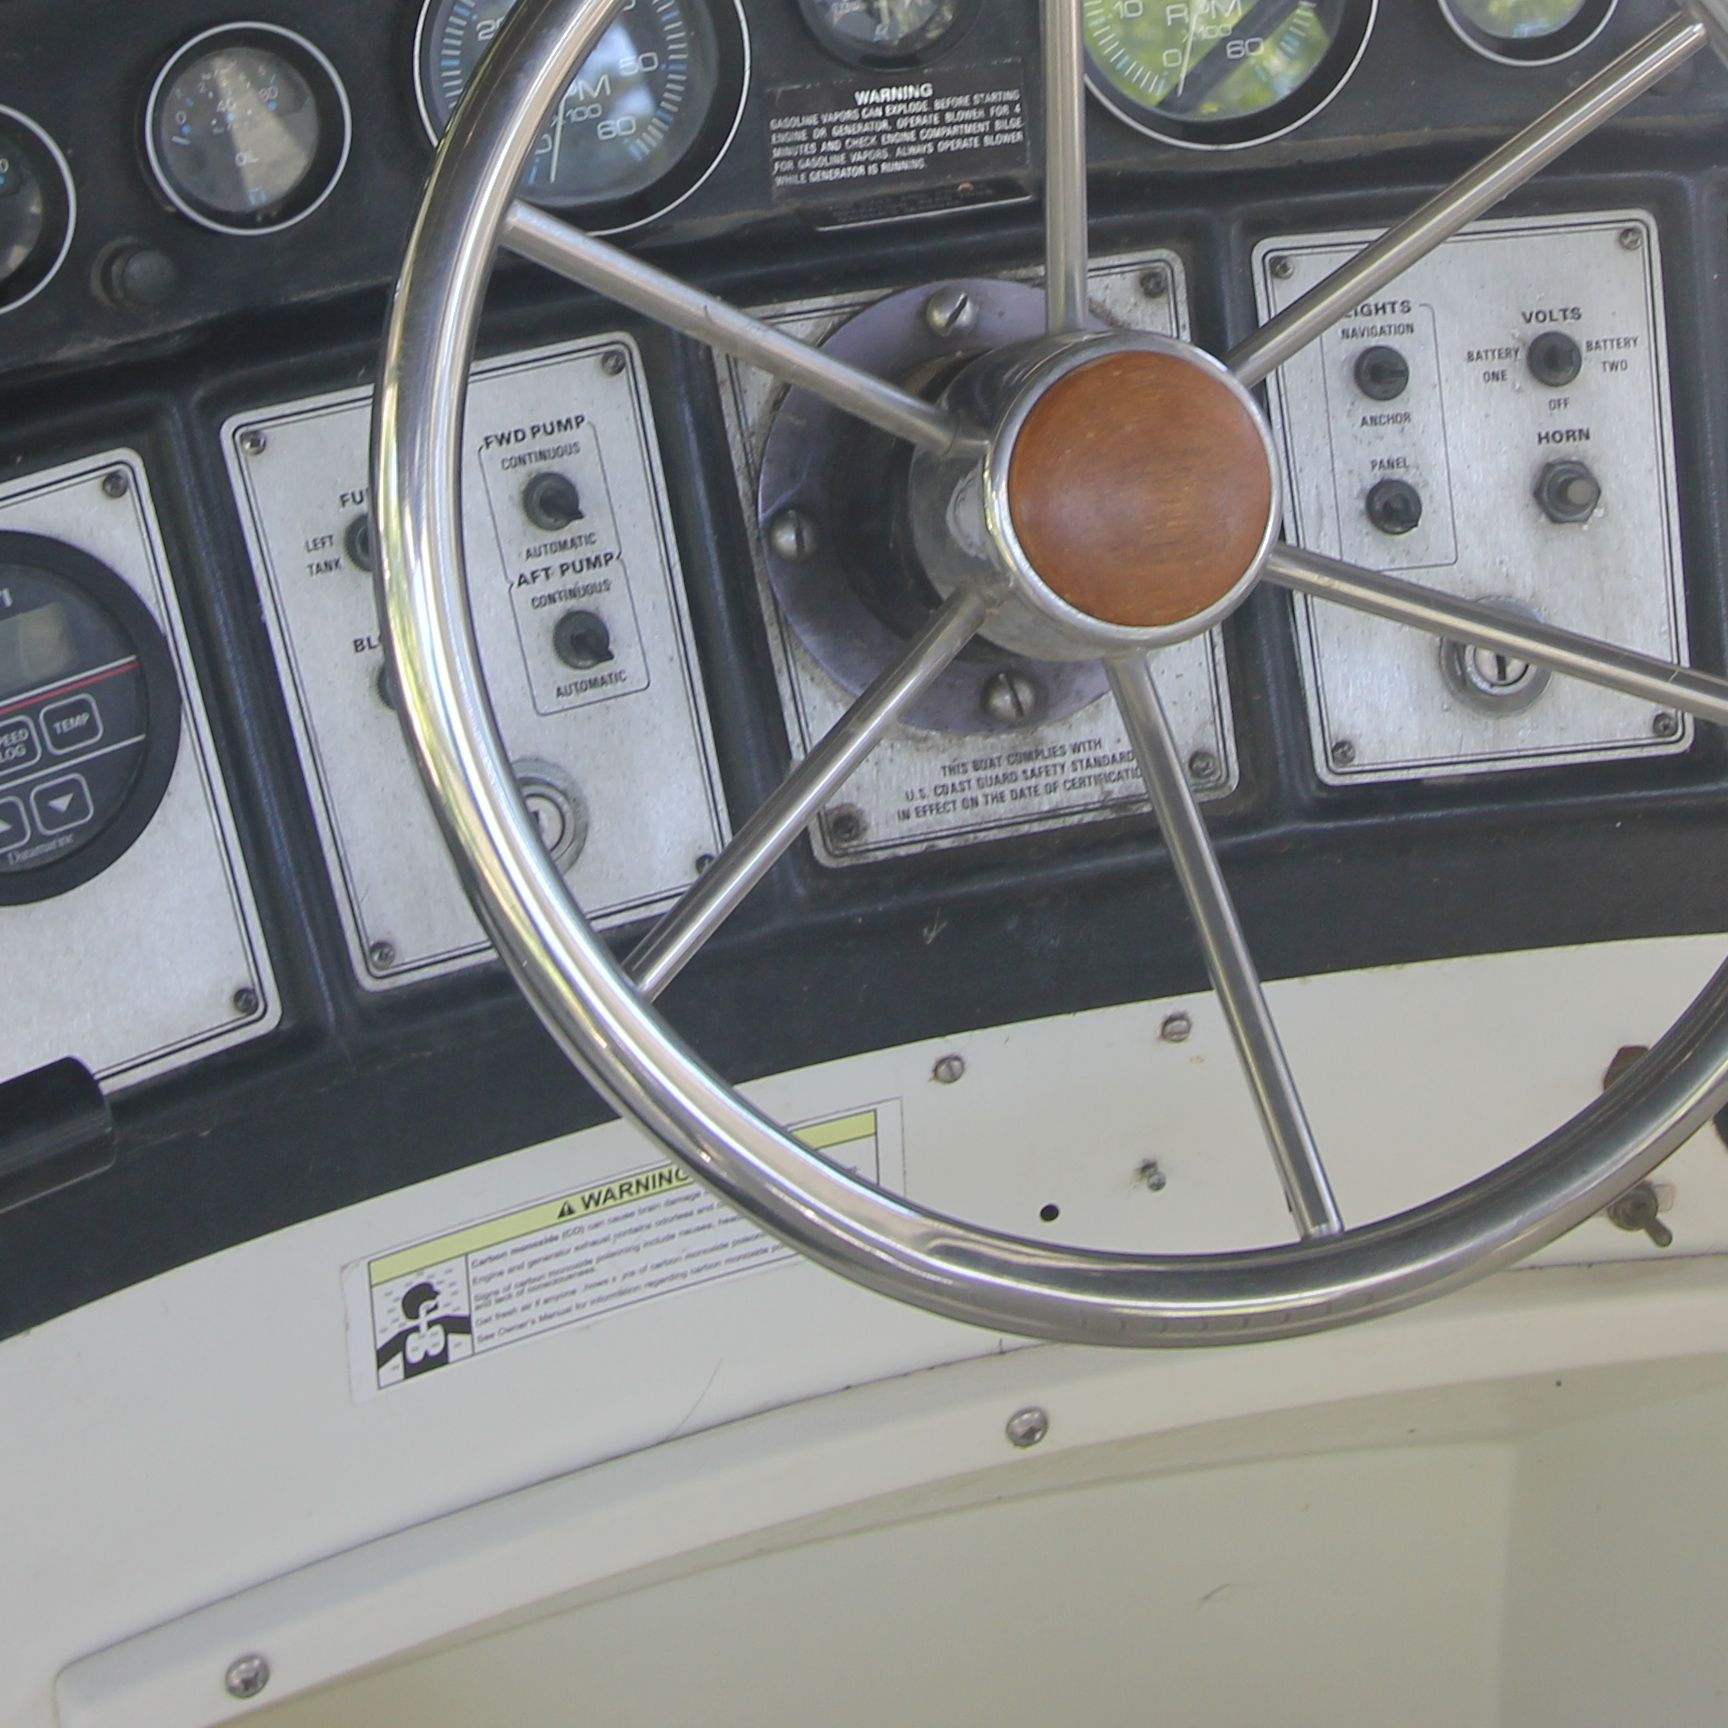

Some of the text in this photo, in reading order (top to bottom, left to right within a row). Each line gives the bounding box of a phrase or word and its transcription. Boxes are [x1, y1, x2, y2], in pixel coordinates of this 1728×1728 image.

[476, 16, 505, 41] 2
[1163, 48, 1182, 68] 0
[1226, 37, 1264, 59] 60
[619, 52, 659, 76] 50
[855, 83, 933, 106] WARNING
[769, 88, 1019, 130] GASOLINE VAPORS CAN BEFORE STARTING
[597, 115, 637, 141] 60
[771, 103, 1020, 144] ENGINE OR OPERATE BLOWER FOR 4
[772, 117, 1022, 159] MINUTES AND CHECK ENGINE COMPARTMENT BILGE
[772, 131, 1022, 173] FOR GASOLINE ALWAYS OPERATE BLOWER
[774, 163, 878, 187] WHILE GENERATOR IS
[1521, 306, 1582, 324] VOLTS
[1341, 322, 1415, 340] NAVIGATION
[1467, 346, 1520, 363] BATTERY
[1585, 335, 1639, 353] BATTERY
[1482, 369, 1508, 383] ONE
[1601, 358, 1629, 373] TWO
[1548, 398, 1570, 412] OFF
[1361, 411, 1411, 427] ANCHOR
[483, 414, 586, 451] FWD PUMP
[1537, 426, 1591, 446] HORN
[500, 442, 581, 471] CONTINUOUS
[1371, 457, 1410, 471] PANEL
[339, 488, 369, 509] FU
[305, 534, 334, 553] LEFT
[525, 531, 598, 561] AUTOMATIC
[307, 557, 341, 577] TANK
[517, 551, 614, 589] AFT PUMP
[531, 578, 612, 610] CONTINUOUS
[555, 669, 627, 700] AUTOMATIC
[52, 712, 90, 735] TEMP
[940, 762, 967, 778] THIS
[1007, 744, 1065, 766] COMPLIES
[1070, 738, 1101, 754] WITH
[933, 748, 1135, 797] COAST GUARD SAFETY STANDARD
[896, 766, 1142, 822] IN EFFECT ON THE DATE OF CERTIFICATIO
